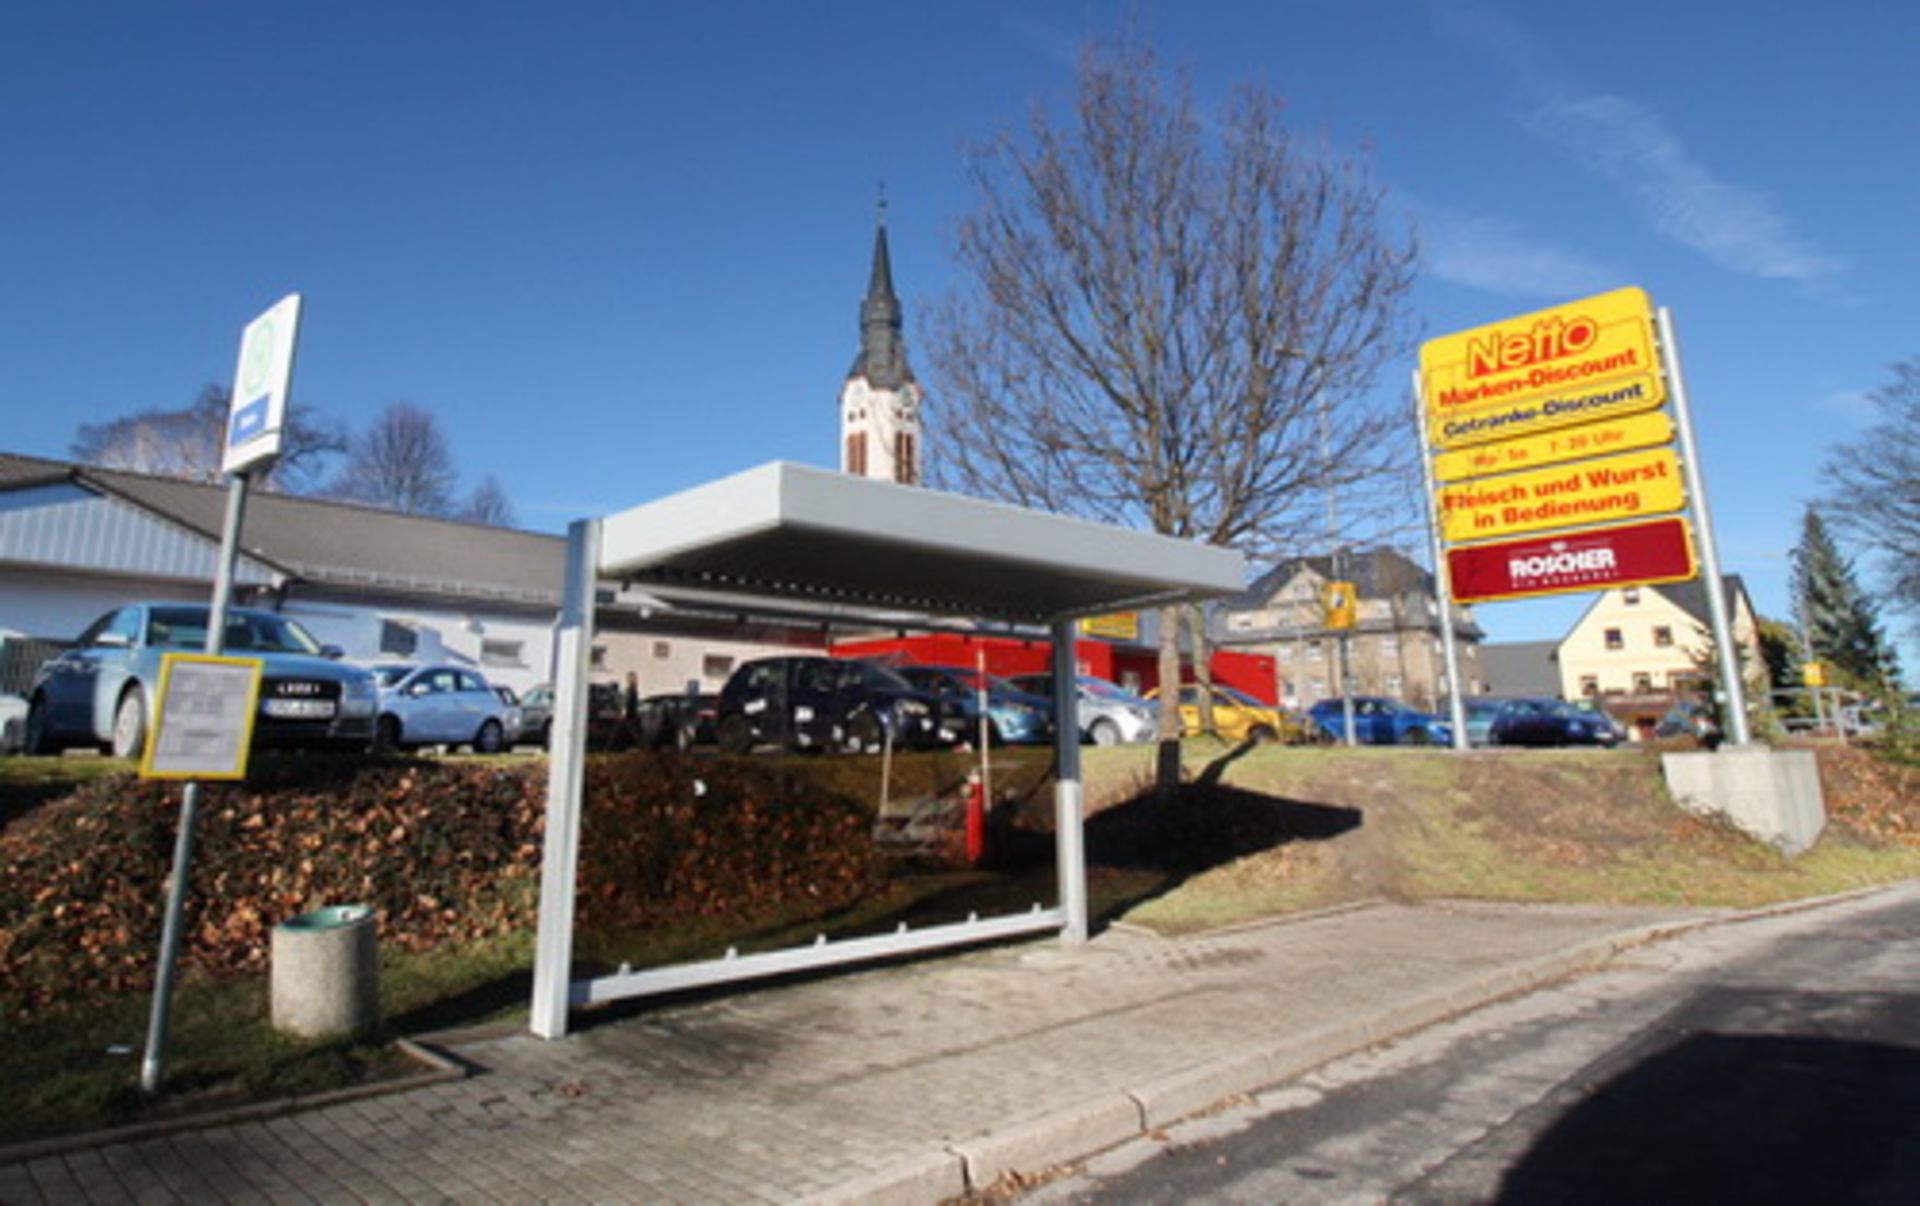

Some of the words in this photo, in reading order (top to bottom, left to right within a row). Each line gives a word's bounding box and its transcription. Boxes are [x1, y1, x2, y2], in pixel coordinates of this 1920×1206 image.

[1467, 315, 1598, 379] Netto
[1439, 347, 1638, 407] Marken-Discount
[1443, 483, 1528, 511] Fleisch
[1533, 474, 1582, 498] und
[1585, 460, 1668, 489] Wurst
[1474, 511, 1495, 529] in
[1502, 490, 1640, 526] Bedienung
